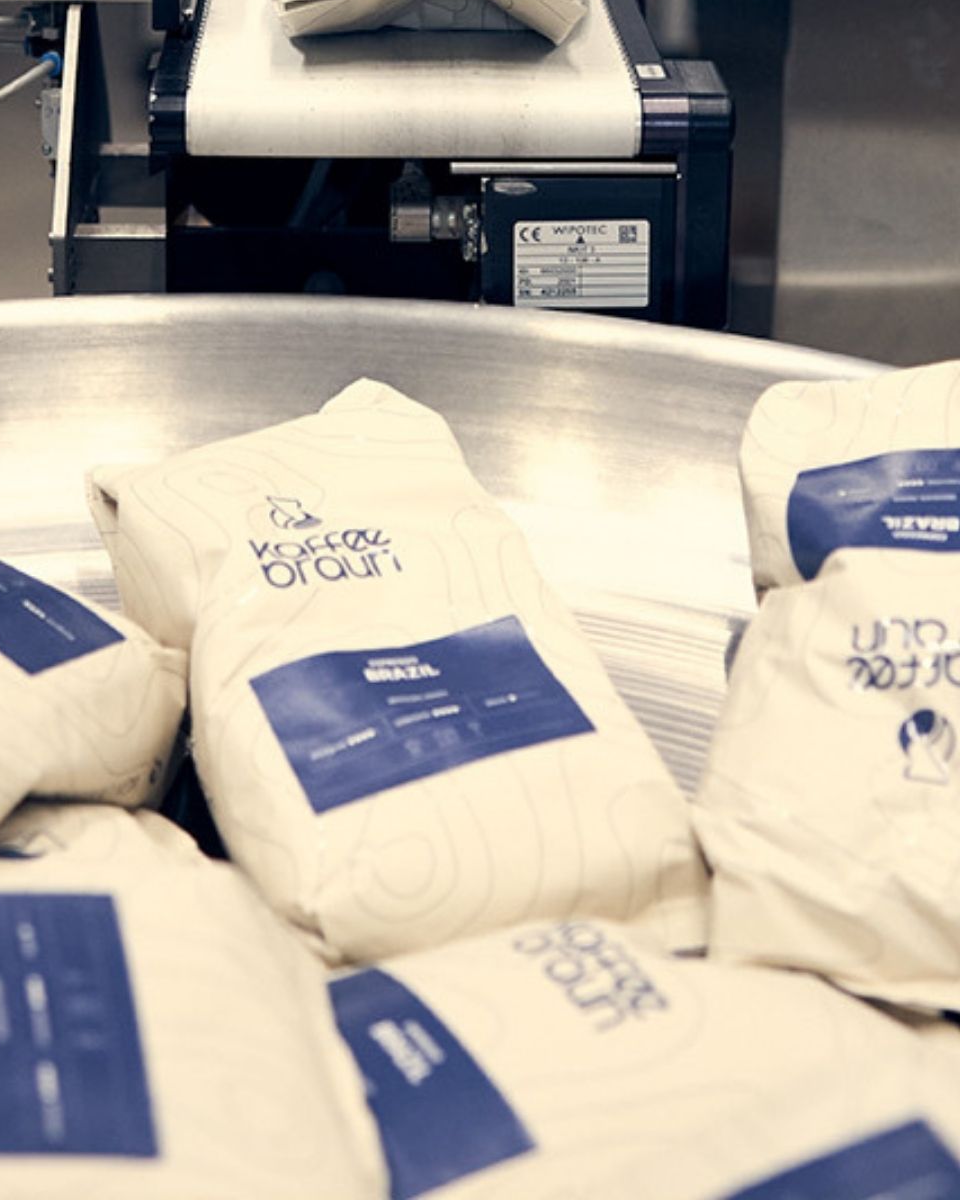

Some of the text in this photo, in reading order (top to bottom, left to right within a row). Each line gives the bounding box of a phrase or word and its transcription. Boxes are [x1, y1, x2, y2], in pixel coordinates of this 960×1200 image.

[552, 224, 608, 236] WIPOTEC
[881, 515, 960, 532] BRAZIL
[261, 550, 403, 589] braun
[363, 663, 442, 684] BRAZIL
